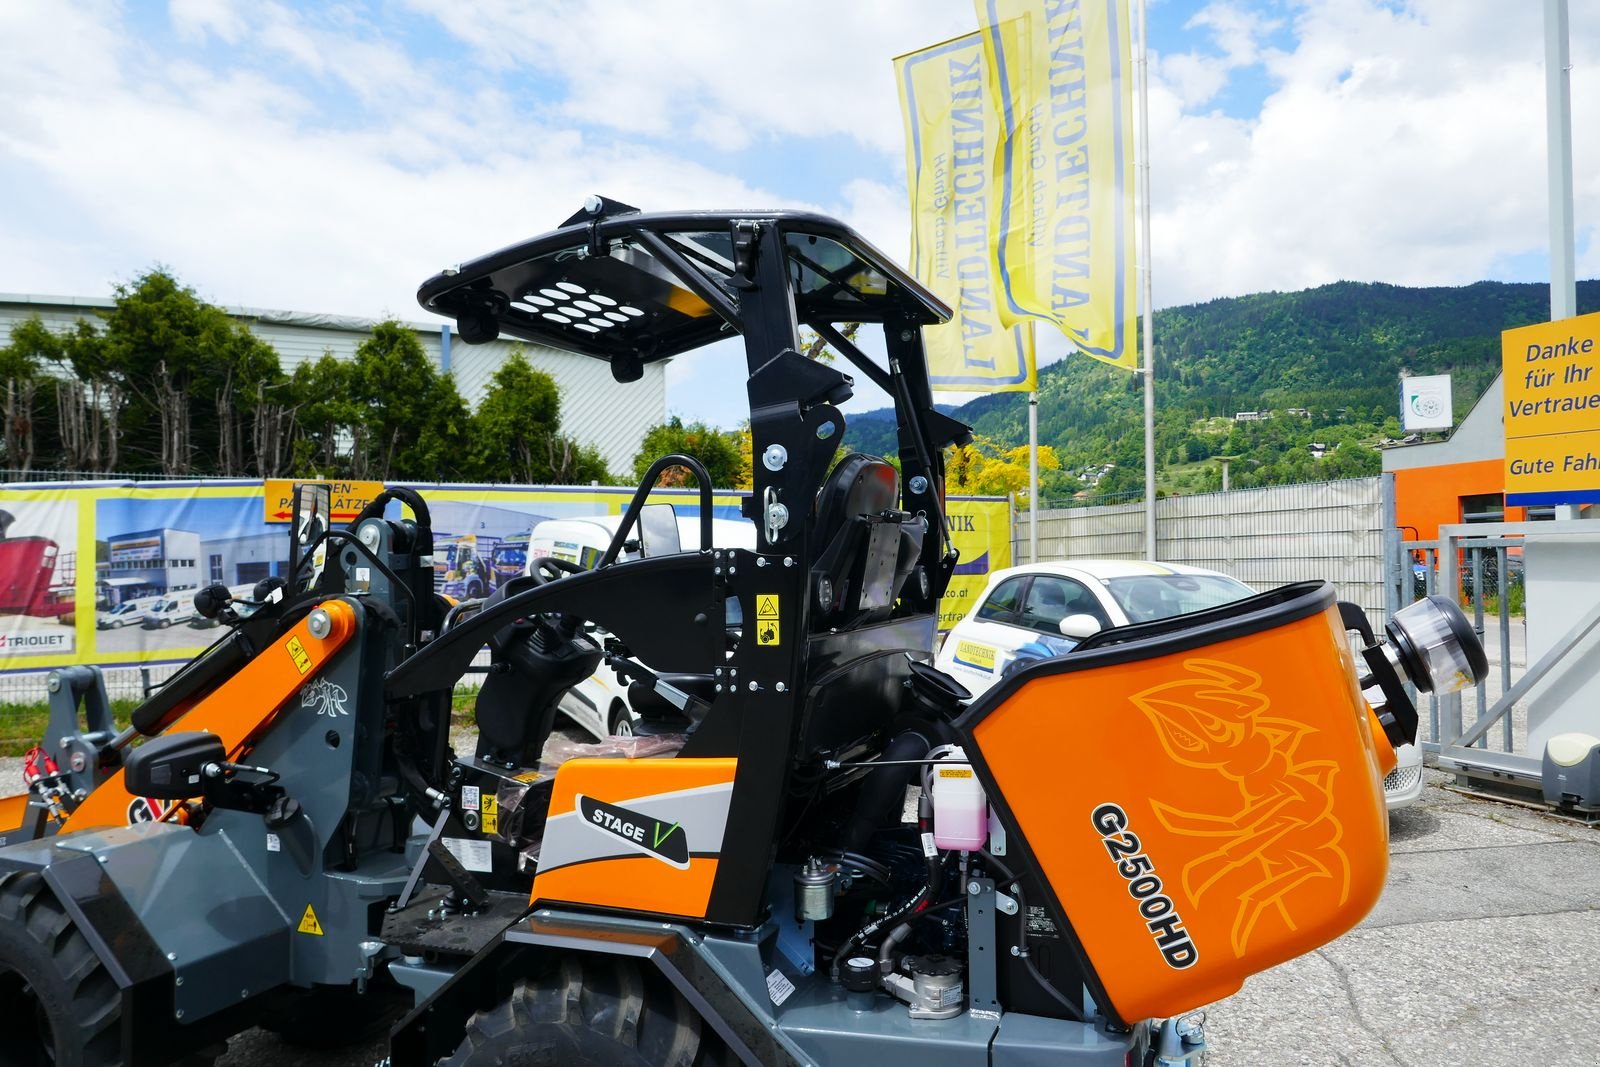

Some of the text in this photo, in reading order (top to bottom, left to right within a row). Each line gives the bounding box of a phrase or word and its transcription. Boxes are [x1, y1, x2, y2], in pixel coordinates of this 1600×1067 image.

[1526, 336, 1594, 362] Danke
[1525, 363, 1593, 389] für Ihr
[1510, 452, 1600, 475] Gute Fah
[592, 809, 646, 842] STAGE
[1091, 802, 1199, 970] G2500HD
